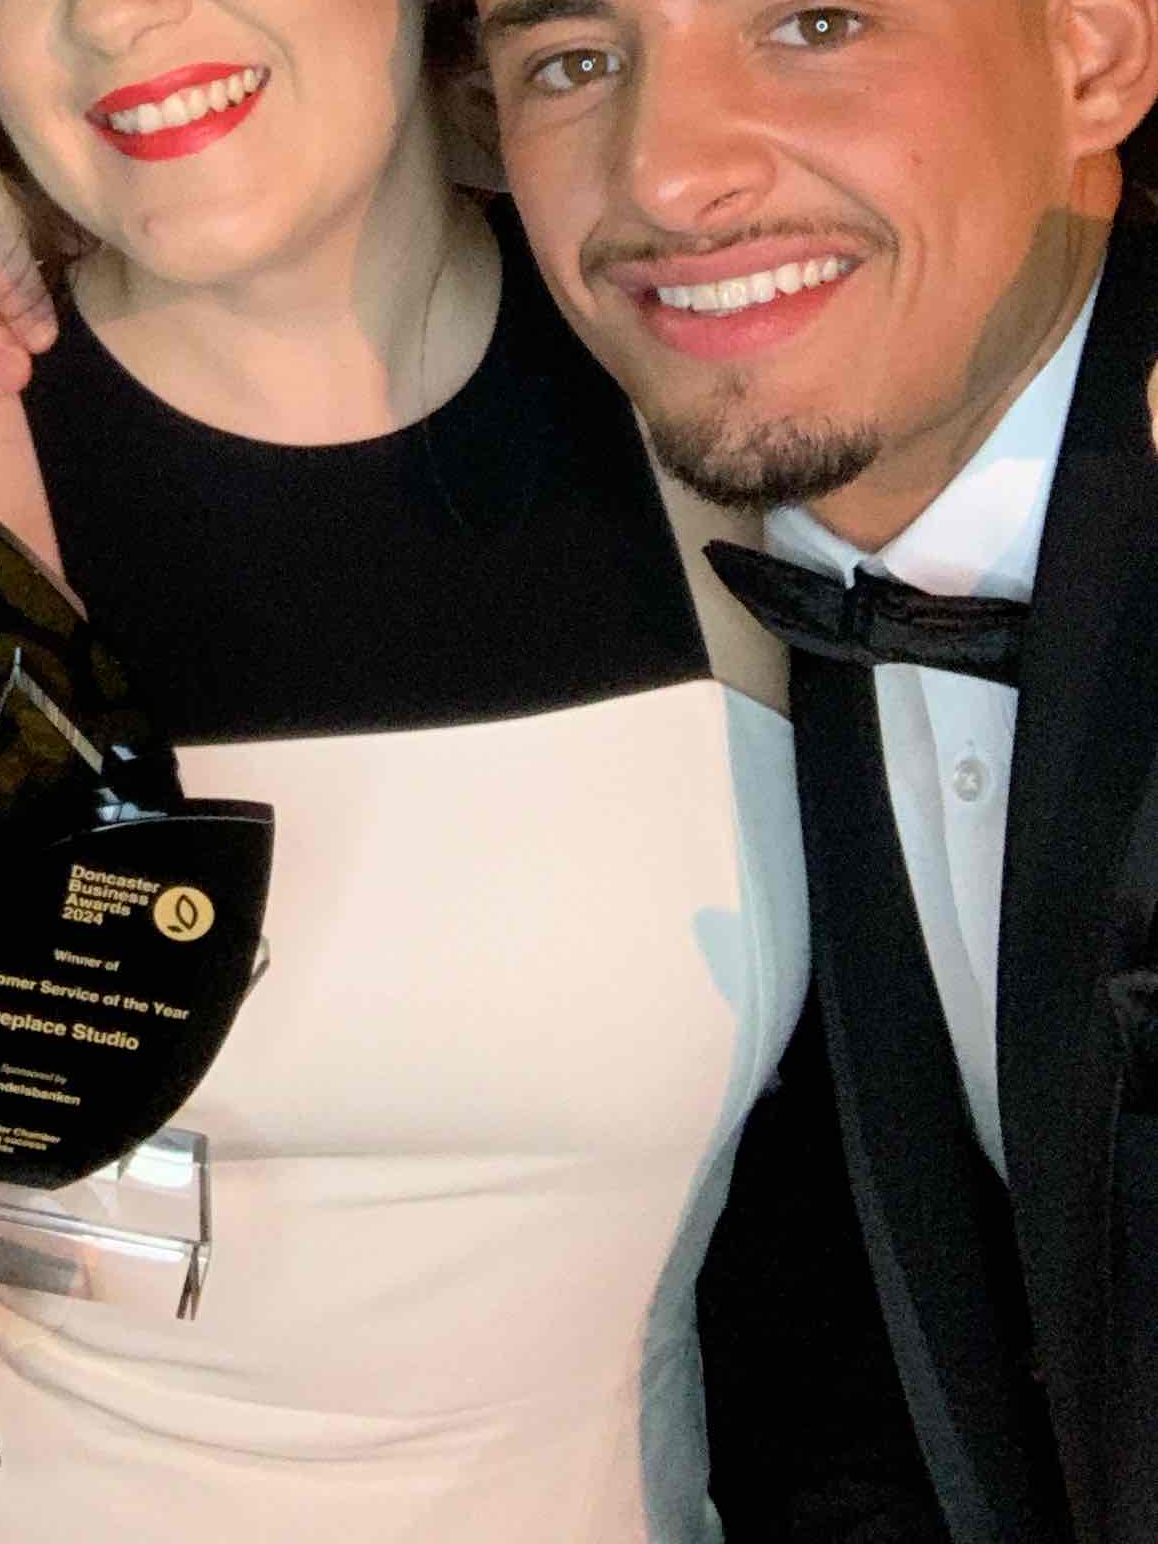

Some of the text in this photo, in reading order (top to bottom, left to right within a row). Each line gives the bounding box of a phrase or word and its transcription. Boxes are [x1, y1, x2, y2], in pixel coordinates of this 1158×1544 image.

[68, 878, 149, 906] Business
[70, 864, 161, 893] Doncaster
[61, 906, 104, 925] 2024
[64, 892, 131, 916] Awards
[53, 948, 121, 972] Winner of
[40, 979, 100, 1003] Service
[102, 993, 120, 1007] of
[123, 997, 149, 1013] the
[152, 1001, 190, 1020] Year
[71, 1022, 140, 1051] Studio
